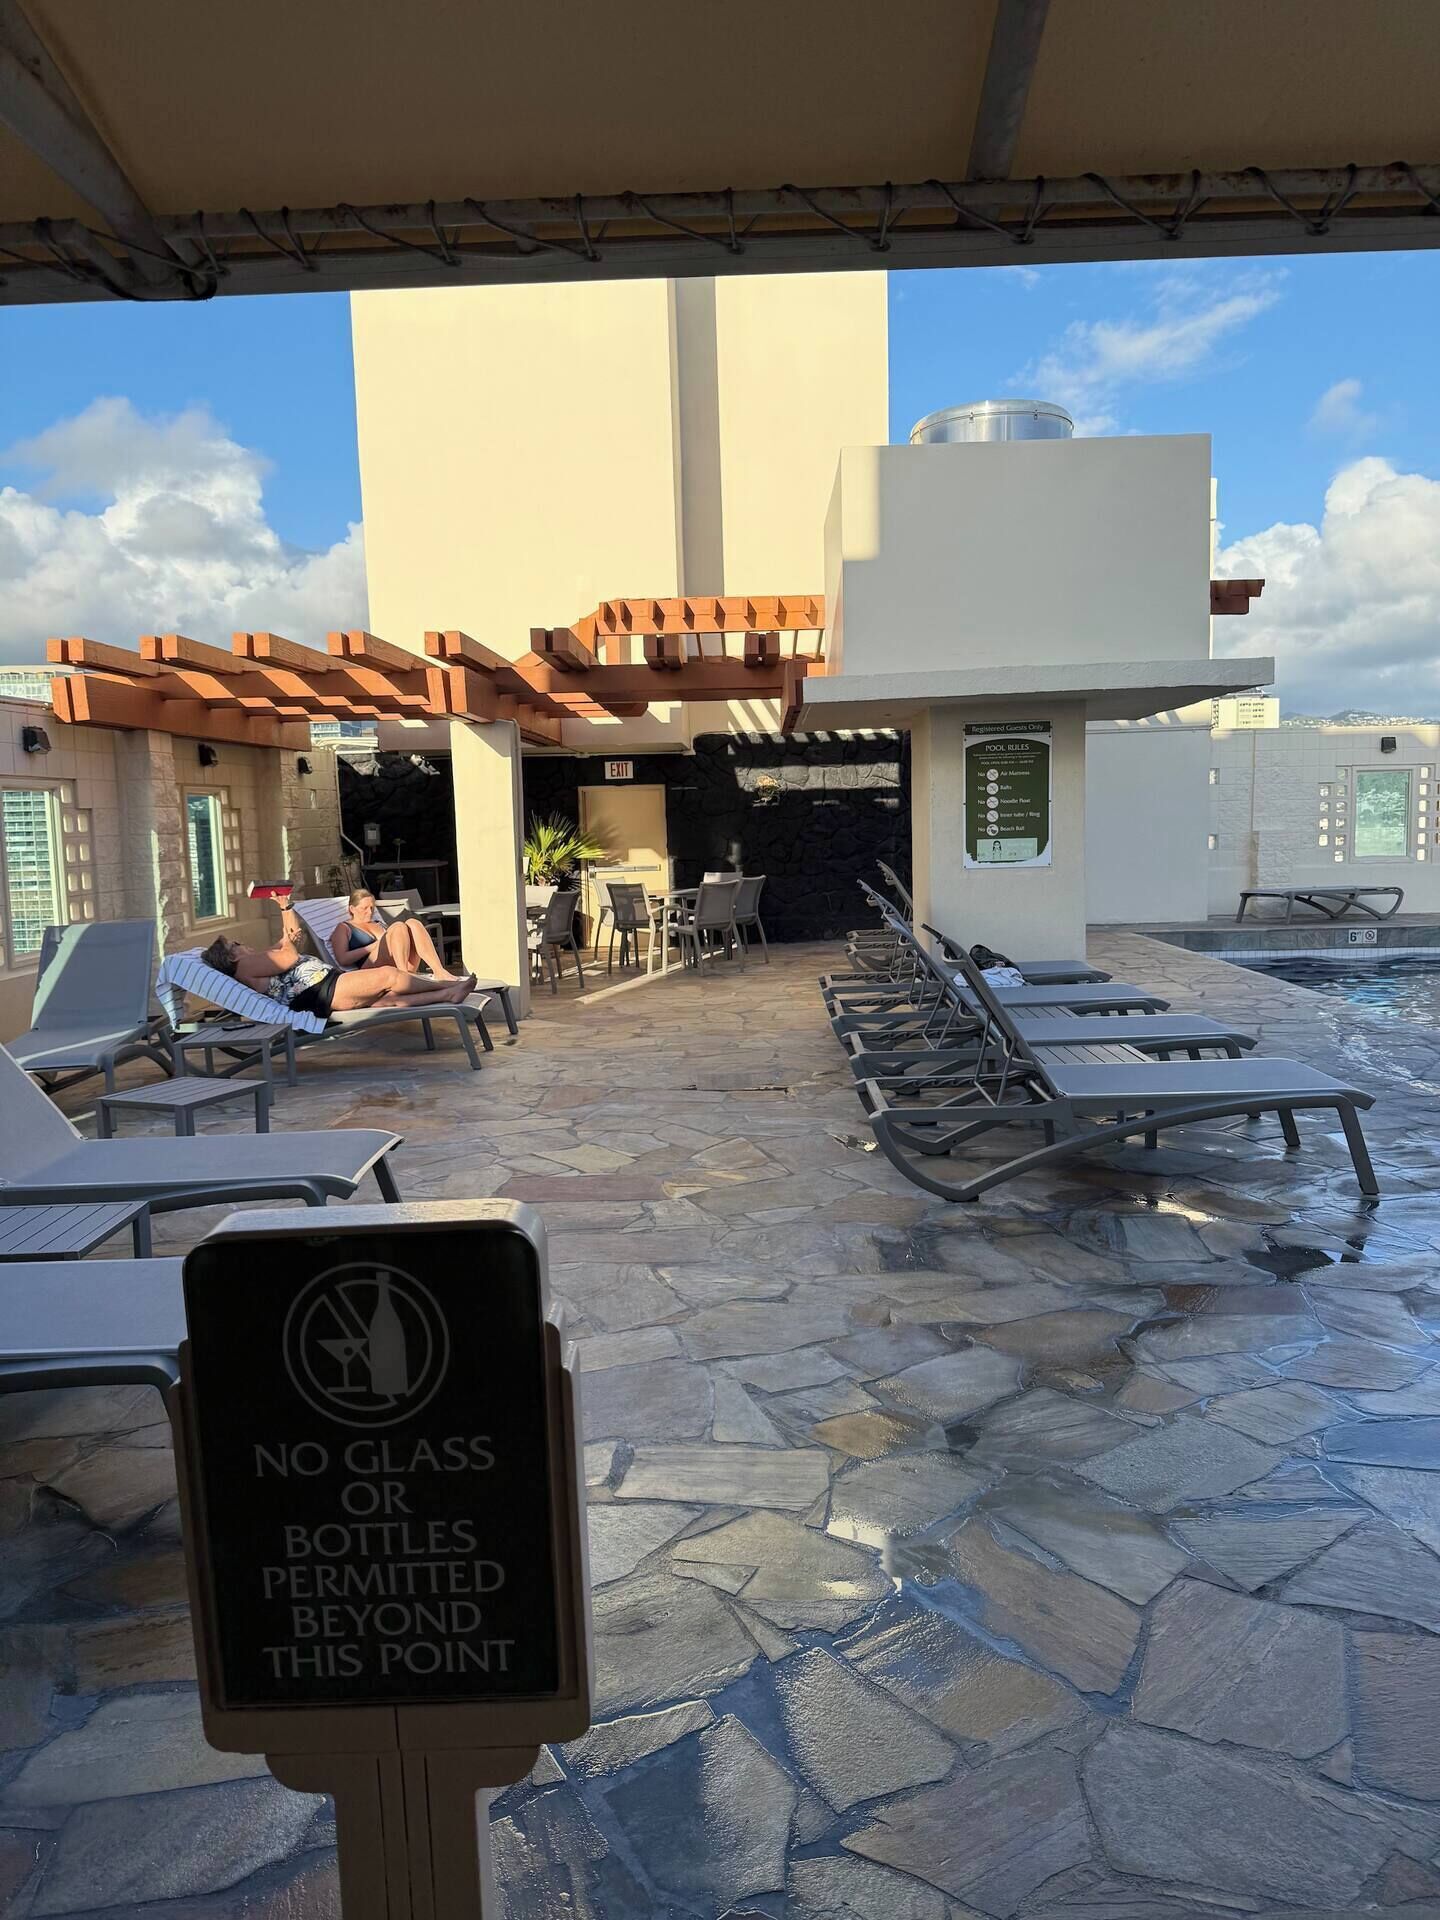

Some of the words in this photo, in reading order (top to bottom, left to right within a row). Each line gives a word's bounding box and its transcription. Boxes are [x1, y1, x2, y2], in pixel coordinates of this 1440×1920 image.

[971, 725, 1005, 734] Registered
[1028, 723, 1044, 731] Only
[985, 744, 1006, 752] POOL
[1007, 743, 1030, 751] RULES
[610, 762, 629, 777] EXIT
[1350, 931, 1357, 942] 6
[254, 1442, 329, 1477] NO
[344, 1435, 495, 1475] GLASS
[341, 1481, 413, 1515] OR
[284, 1519, 477, 1558] BOTTLES
[262, 1560, 505, 1599] PERMITTED
[292, 1601, 482, 1638] BEYOND
[263, 1643, 363, 1678] THIS
[380, 1639, 516, 1675] POINT
